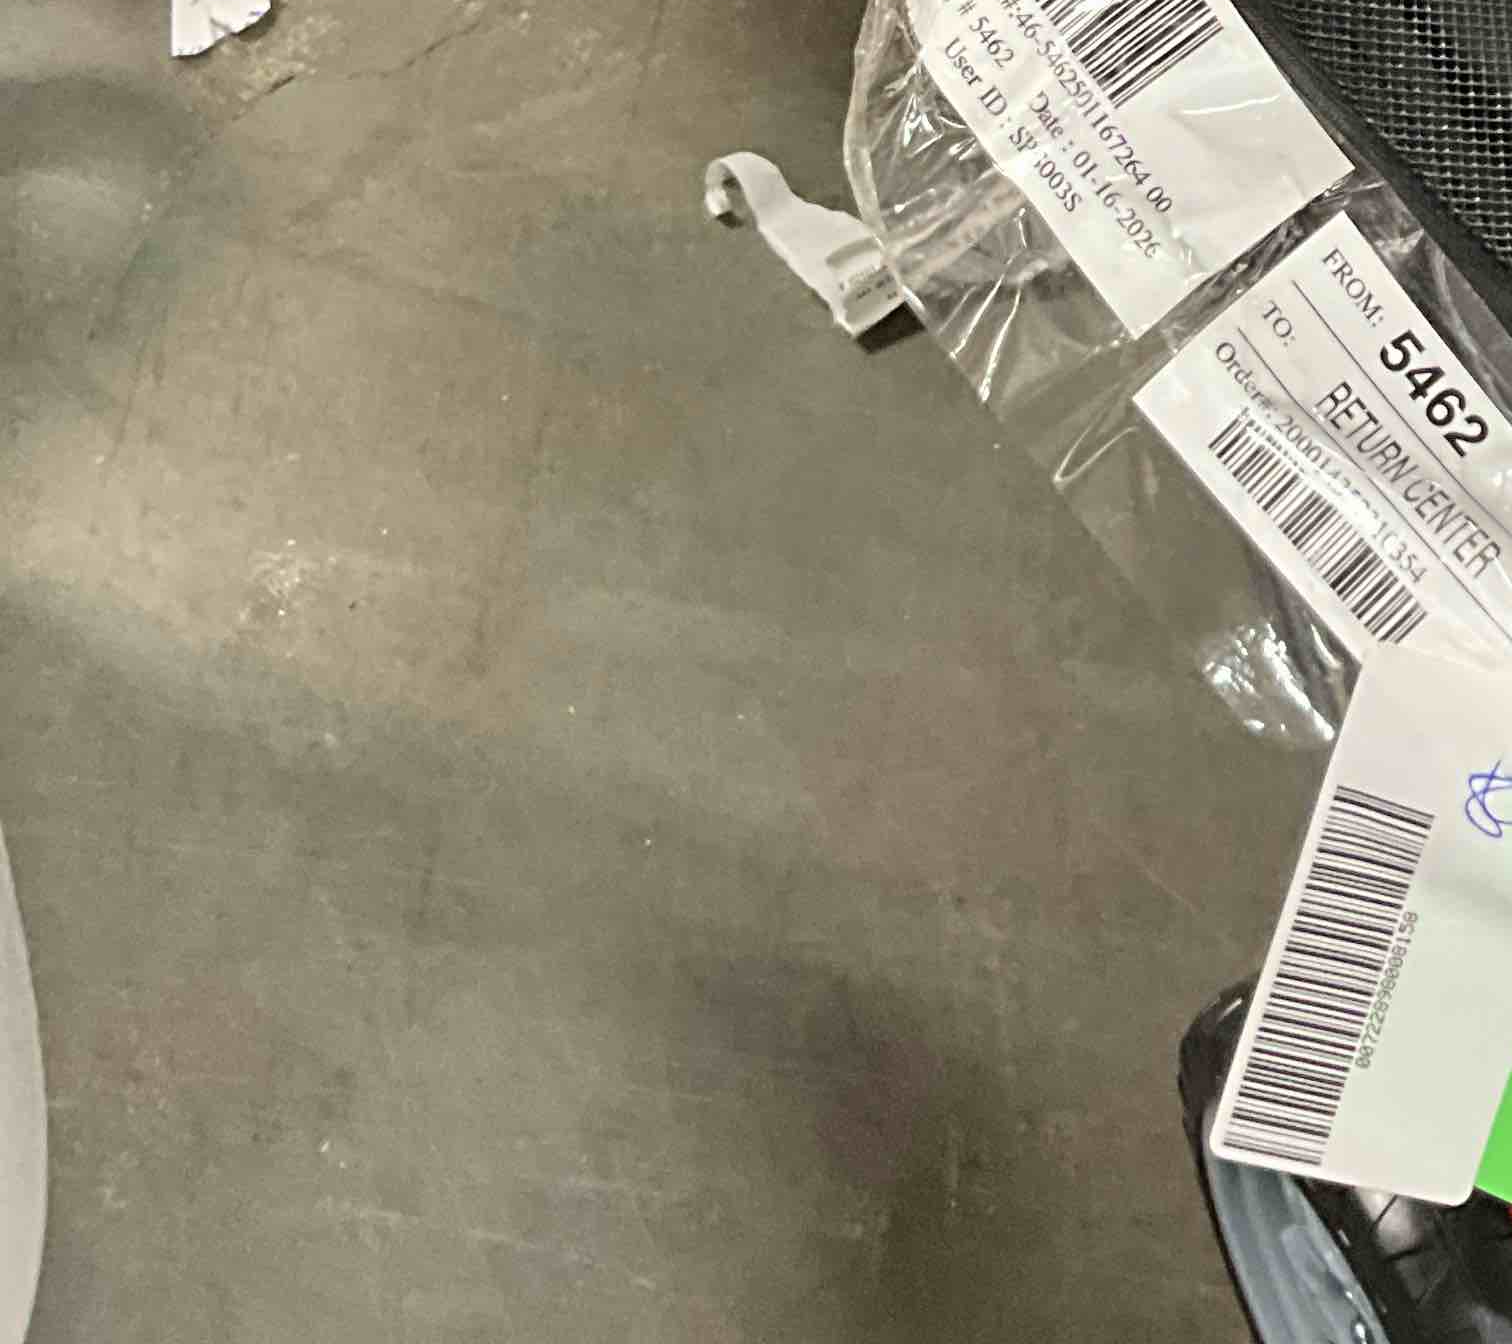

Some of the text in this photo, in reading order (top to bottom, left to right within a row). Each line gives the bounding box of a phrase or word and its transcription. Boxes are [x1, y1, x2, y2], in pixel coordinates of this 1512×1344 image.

[944, 38, 982, 89] User
[980, 85, 1008, 117] ID
[969, 15, 1015, 70] 5462
[1028, 90, 1064, 140] Date
[1321, 247, 1490, 458] FROM: 5462
[1260, 299, 1296, 347] TO:
[1314, 381, 1420, 484] RETURN
[1403, 478, 1501, 579] CENTER
